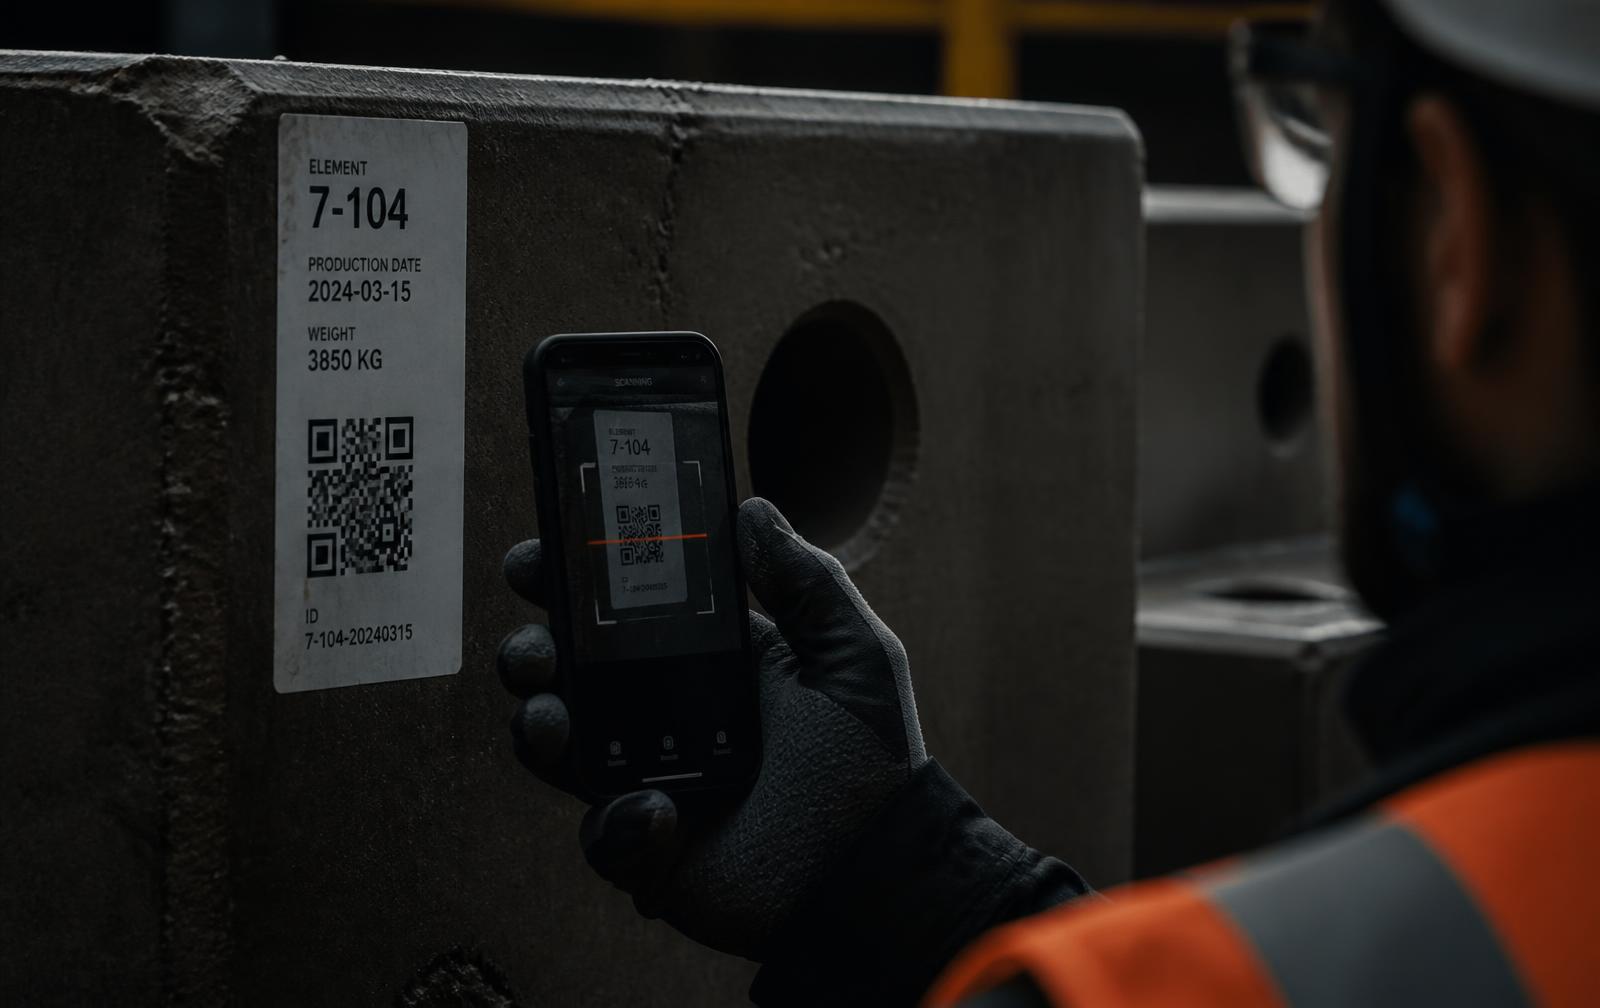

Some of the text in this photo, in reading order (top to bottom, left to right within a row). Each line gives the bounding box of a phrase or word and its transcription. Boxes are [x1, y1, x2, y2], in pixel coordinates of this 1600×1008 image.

[309, 159, 367, 176] ELEMENT
[309, 185, 408, 230] 7-104
[308, 257, 421, 273] PRODUCTION DATE
[308, 280, 411, 302] 2024-03-15
[308, 326, 356, 341] WEIGHT
[308, 348, 383, 372] 3850 KG
[609, 438, 651, 456] 7-104
[305, 608, 319, 624] ID
[305, 623, 413, 650] 7-104-20240315
